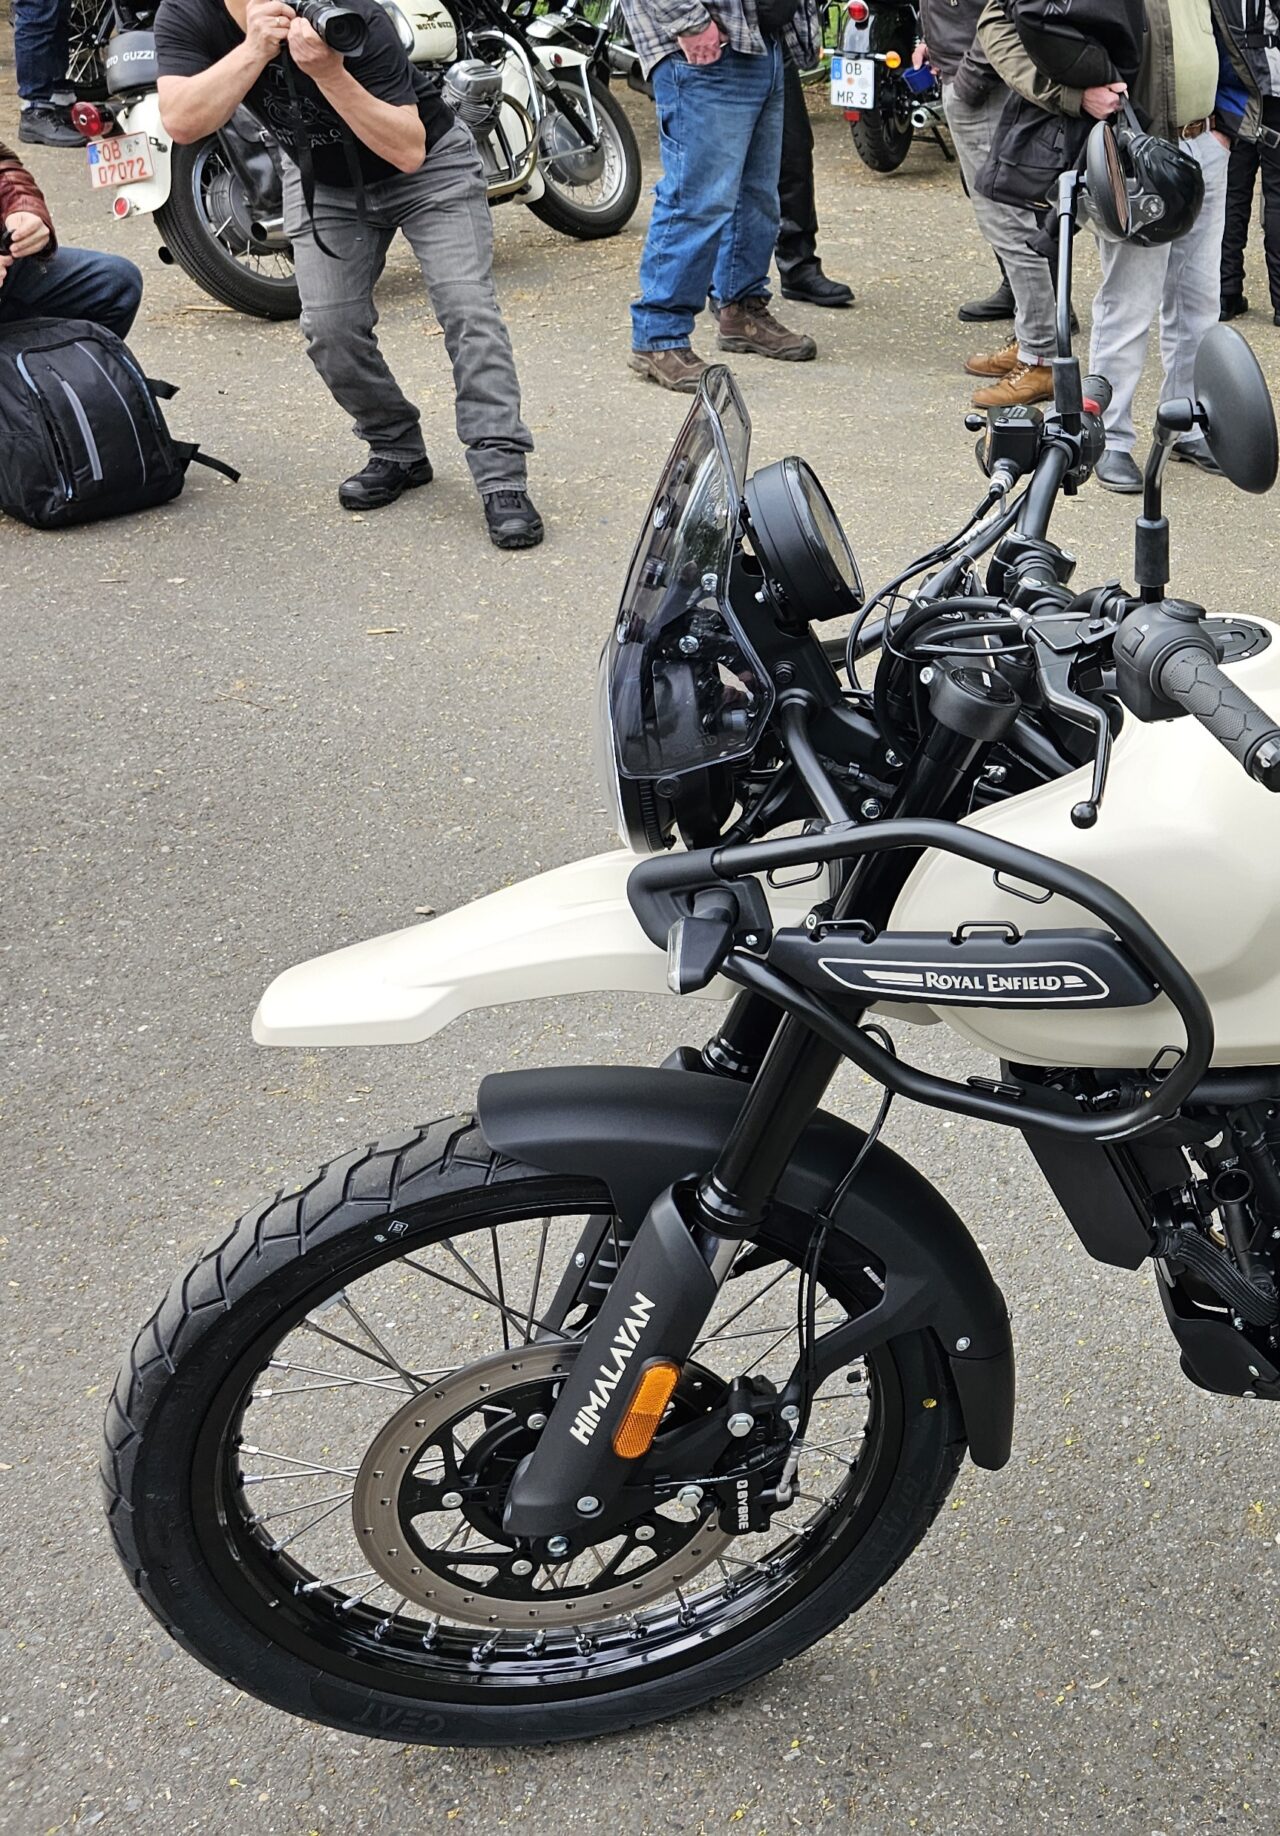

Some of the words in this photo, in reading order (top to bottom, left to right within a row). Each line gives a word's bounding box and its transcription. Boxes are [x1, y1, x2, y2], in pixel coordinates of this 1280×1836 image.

[123, 50, 155, 62] GUZZI
[845, 62, 862, 75] OB
[837, 91, 854, 104] MR
[860, 92, 868, 105] 3
[102, 140, 122, 162] OB
[98, 157, 148, 185] 07072
[925, 971, 984, 990] ROYAL
[986, 974, 1062, 992] ENFIELD
[569, 1291, 656, 1446] HIMALAYAN
[737, 1488, 750, 1531] BYBRE
[352, 1702, 446, 1733] CEAT
